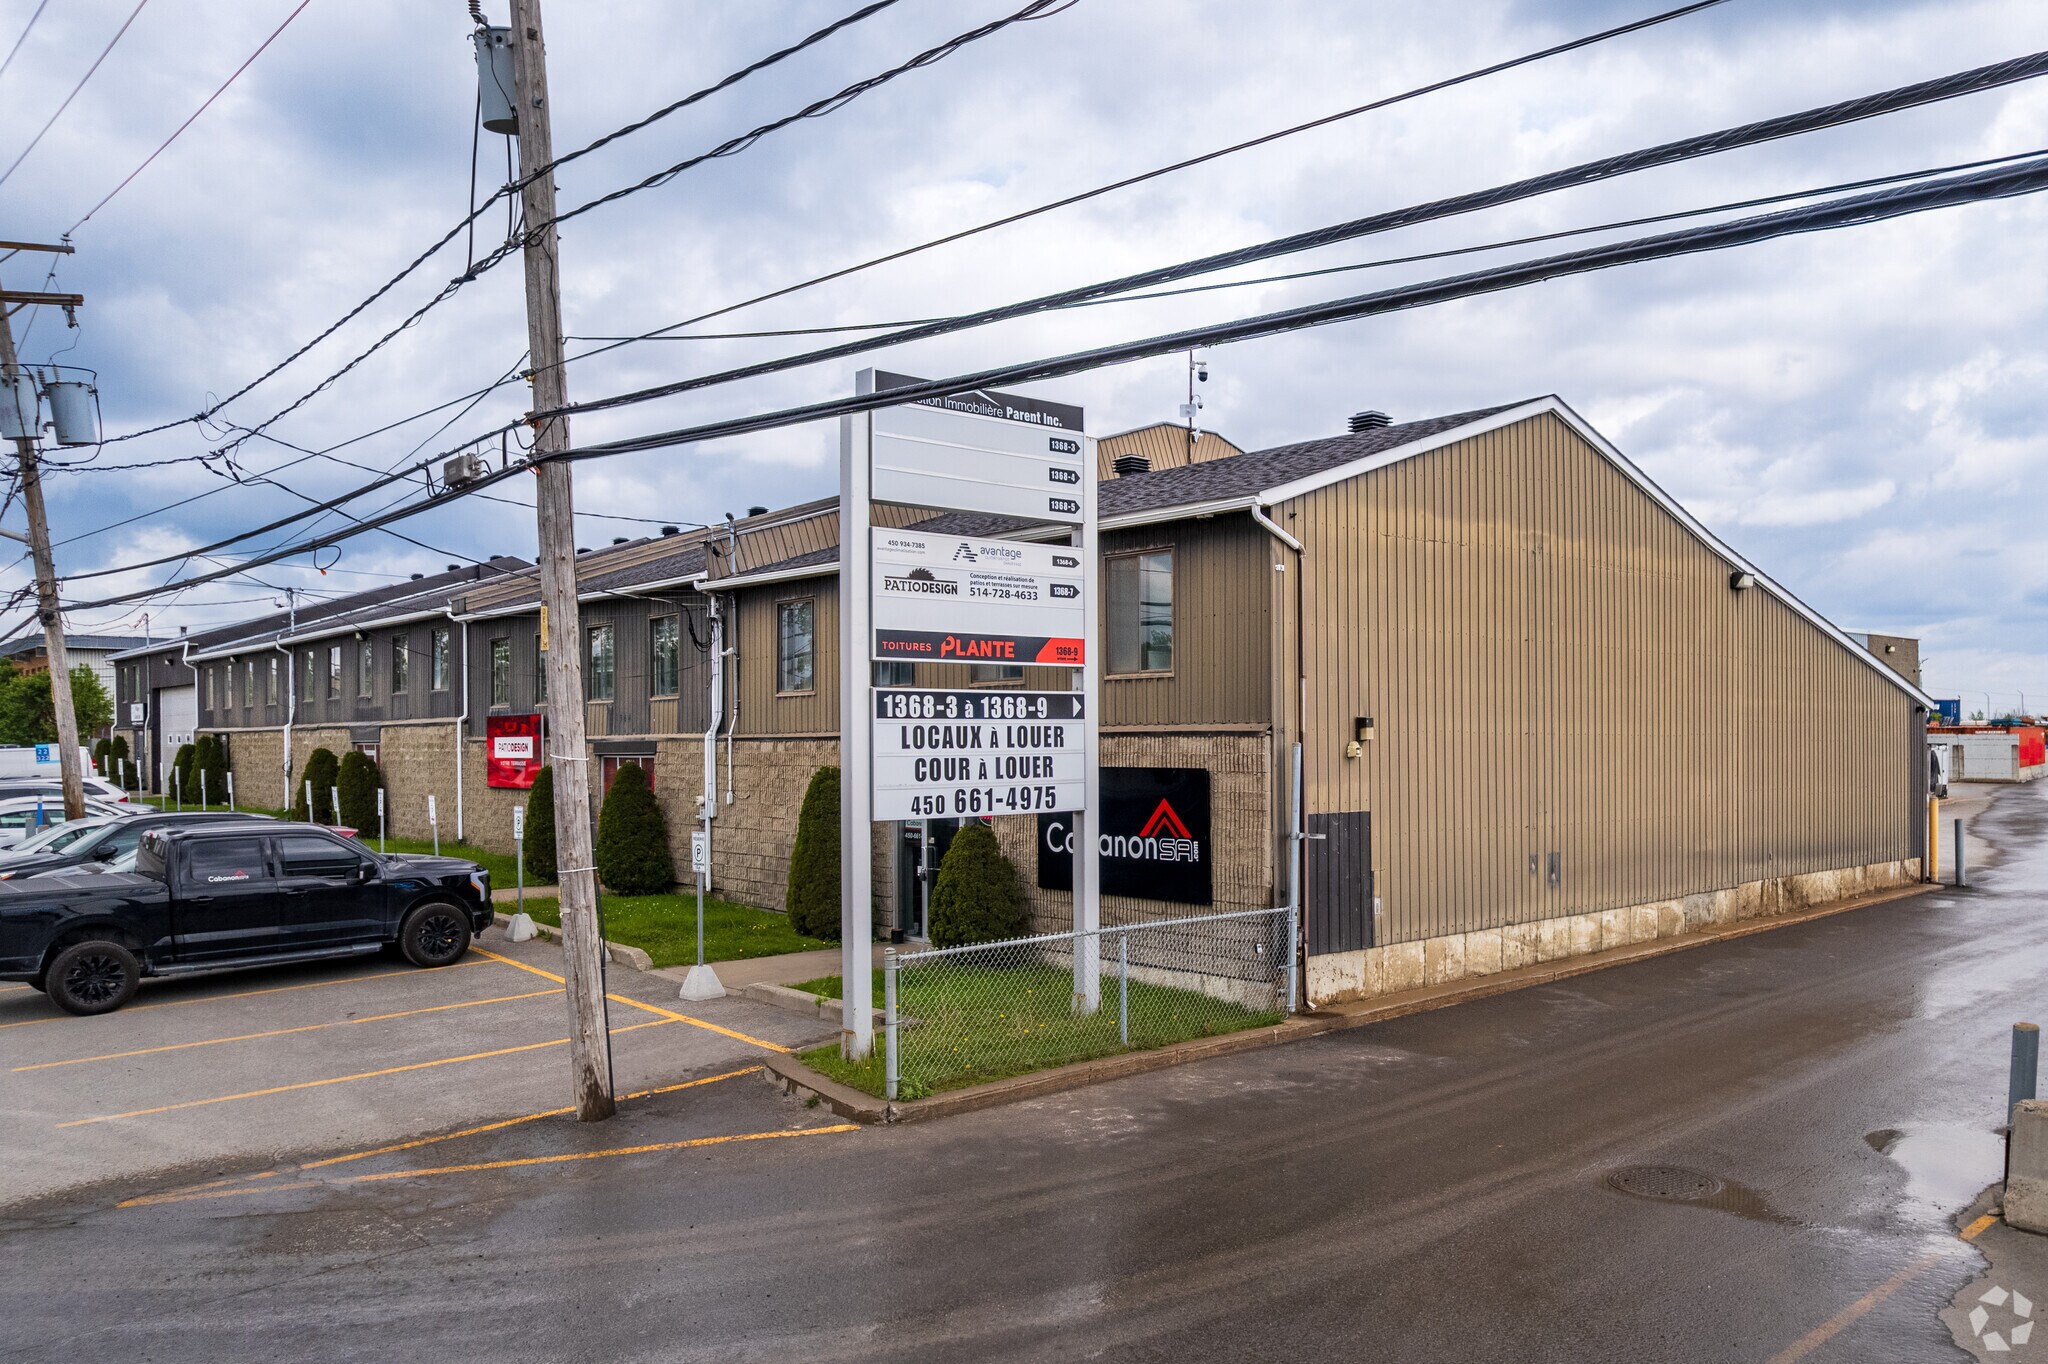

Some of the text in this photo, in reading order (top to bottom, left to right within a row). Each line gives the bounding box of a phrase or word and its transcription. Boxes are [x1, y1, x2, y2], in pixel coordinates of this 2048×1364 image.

[945, 397, 1003, 417] Immobilière
[1006, 406, 1041, 423] Parent
[1043, 412, 1062, 427] Inc.
[1051, 440, 1076, 452] 1368-3
[1051, 470, 1076, 482] 1368-4
[1051, 500, 1076, 512] 1368-5
[900, 541, 925, 549] 934-7385
[980, 546, 1022, 560] avantage
[1056, 558, 1073, 566] 1368-6
[969, 572, 997, 580] Conception
[1003, 575, 1028, 583] réalisation
[885, 579, 958, 595] PATIODESIGN
[969, 587, 1038, 601] 514-728-4633
[1053, 586, 1074, 596] 1368-7
[882, 635, 1015, 659] TOITURES PLANTE
[1055, 646, 1079, 656] 1368-9
[883, 694, 1048, 719] 1368-3 à 1368-9
[901, 725, 1065, 749] LOCAUX À LOUER
[914, 755, 1054, 782] COUR À LOUER
[911, 786, 1057, 815] 450 661-4975
